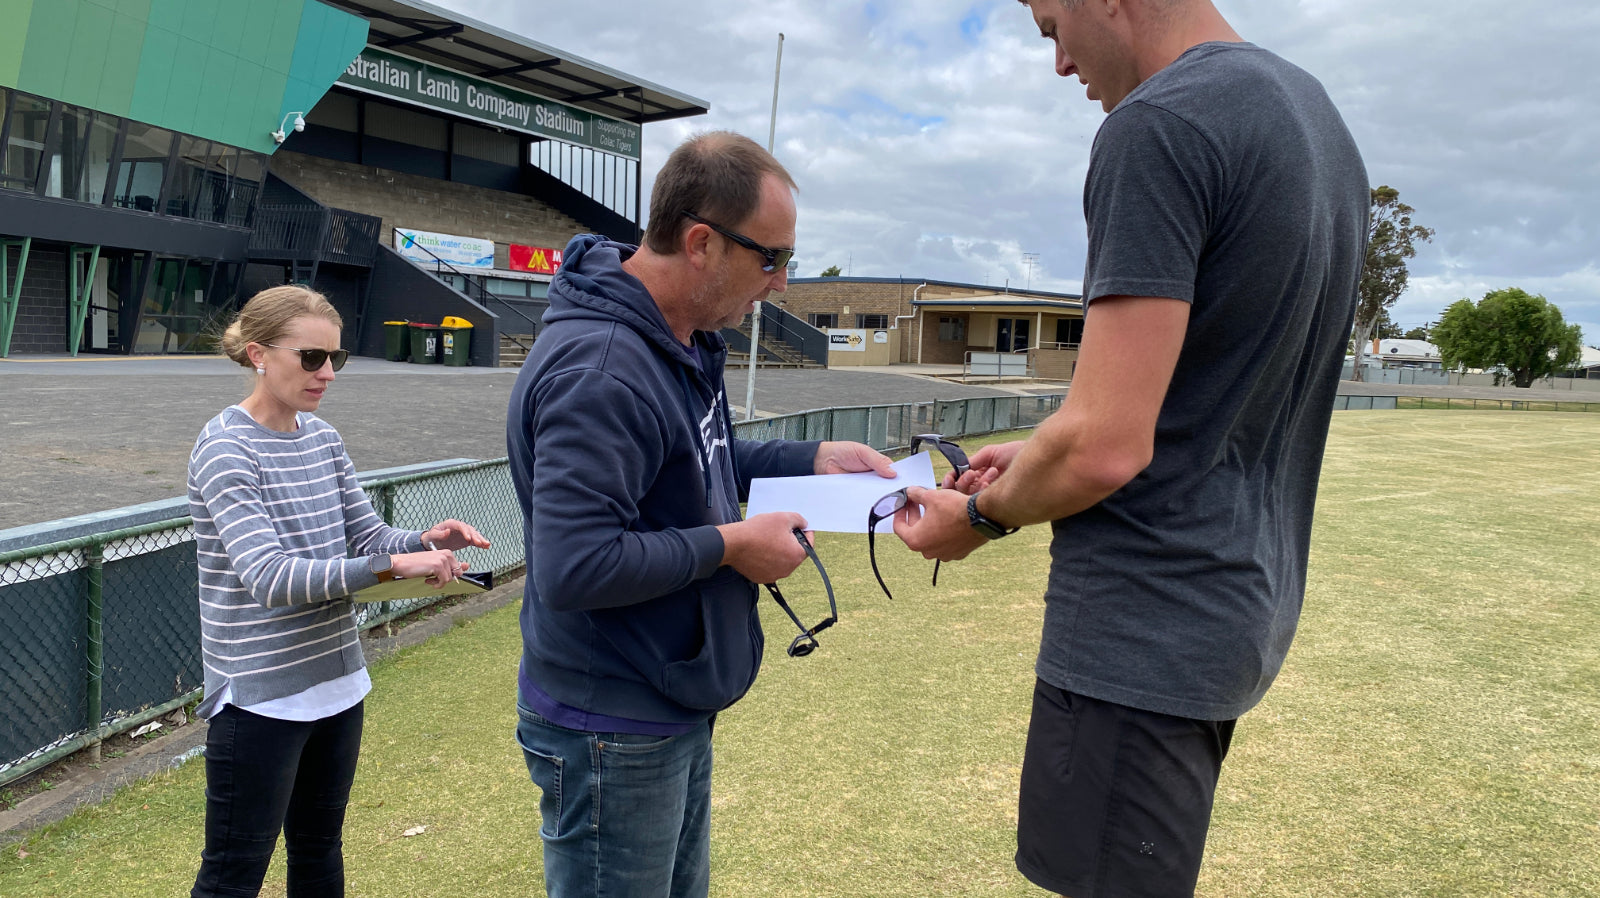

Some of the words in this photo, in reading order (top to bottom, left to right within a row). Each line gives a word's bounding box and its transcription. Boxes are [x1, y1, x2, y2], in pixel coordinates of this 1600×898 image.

[344, 54, 410, 90] stralian
[417, 70, 460, 103] Lamb
[466, 84, 530, 126] Company
[535, 104, 584, 136] Stadium
[597, 119, 627, 138] Supporting
[627, 127, 636, 139] the
[600, 134, 615, 148] Colac
[616, 138, 632, 152] Tigers
